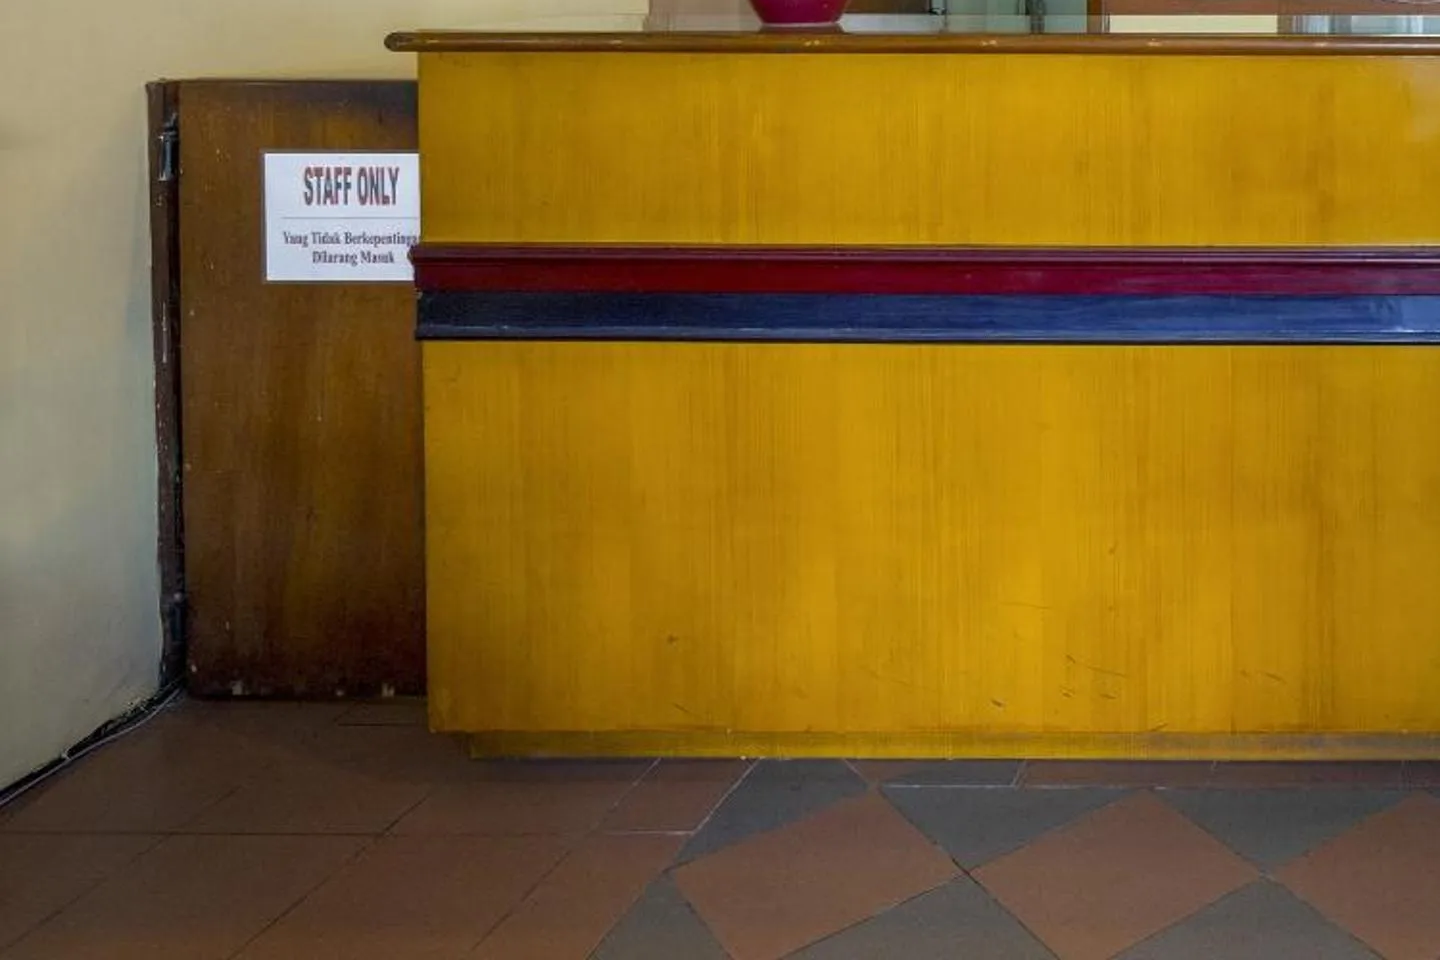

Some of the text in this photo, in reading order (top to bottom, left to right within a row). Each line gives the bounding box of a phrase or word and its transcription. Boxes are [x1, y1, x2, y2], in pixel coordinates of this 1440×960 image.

[303, 166, 400, 206] STAFF ONLY
[282, 231, 309, 248] Yang
[311, 231, 341, 245] Tidak
[312, 251, 395, 266] Dilarang Masuk
